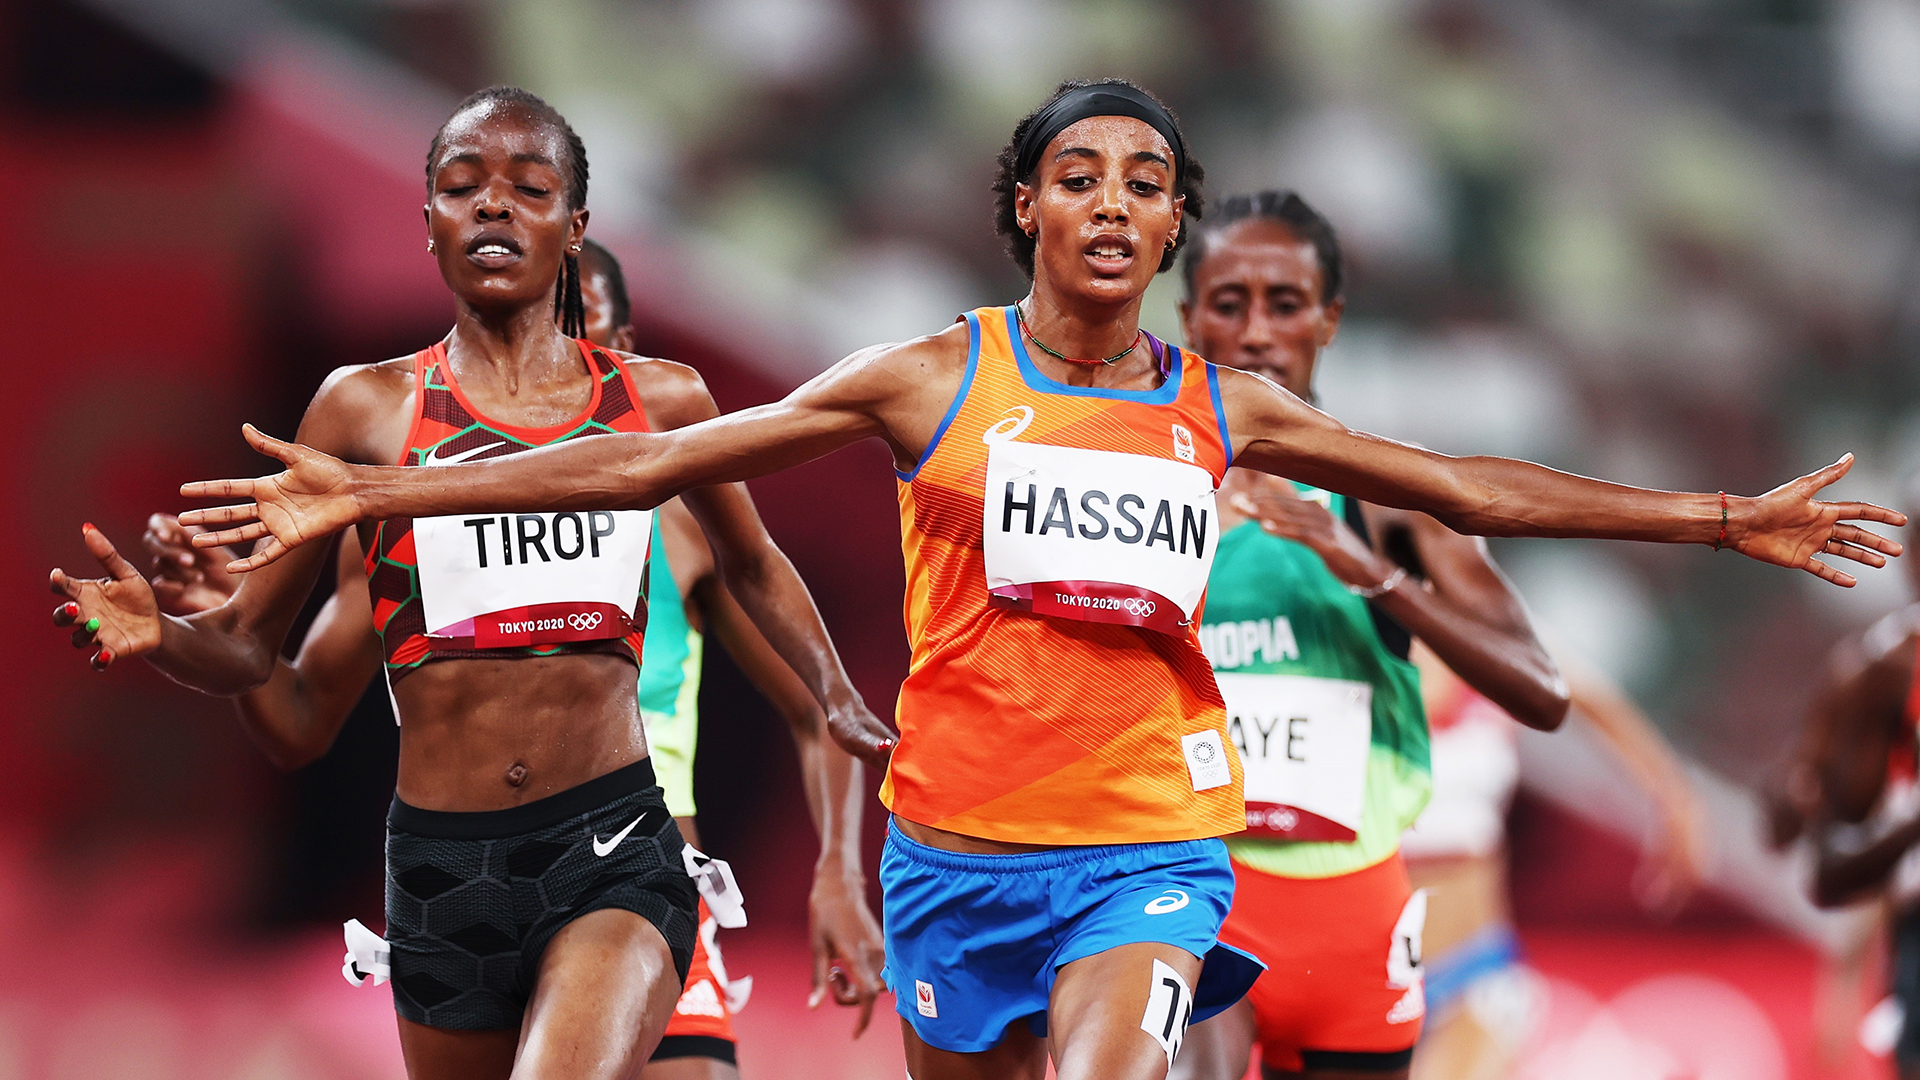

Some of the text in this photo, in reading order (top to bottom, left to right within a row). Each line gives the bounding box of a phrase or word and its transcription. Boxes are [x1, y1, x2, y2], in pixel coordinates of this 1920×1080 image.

[464, 510, 615, 568] TIROP
[1002, 481, 1207, 560] HASSAN
[1055, 593, 1120, 611] TOKYO 2020
[498, 617, 565, 635] TOKYO 2020
[1229, 716, 1309, 762] AYE
